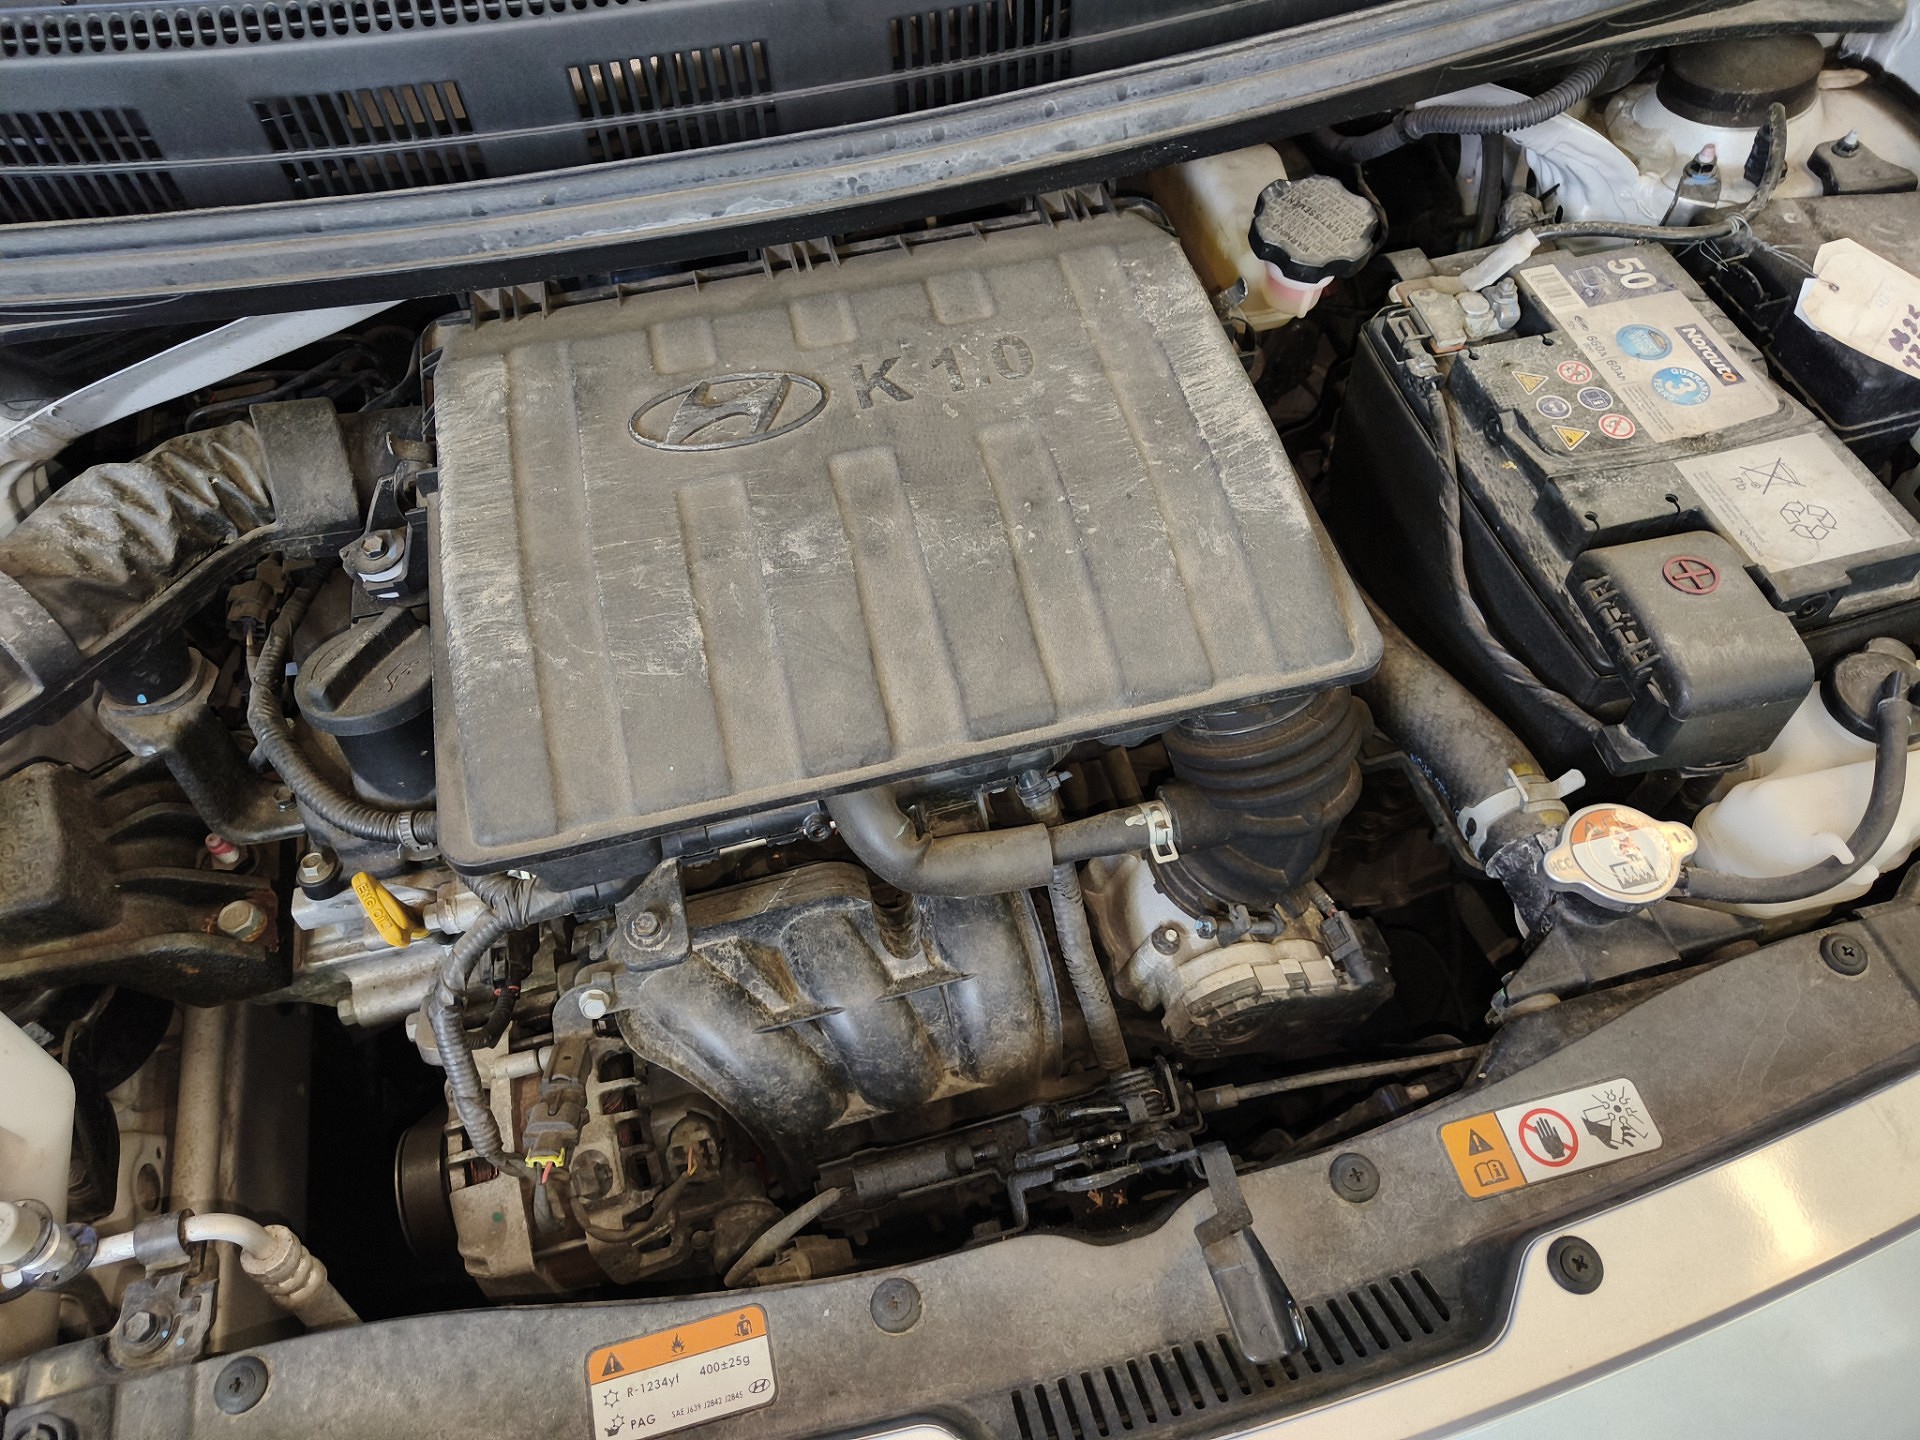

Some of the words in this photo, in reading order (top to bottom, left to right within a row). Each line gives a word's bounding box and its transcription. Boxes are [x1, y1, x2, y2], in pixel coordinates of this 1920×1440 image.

[1272, 224, 1311, 253] WARNING
[1607, 257, 1657, 290] 50
[850, 356, 914, 410] K
[929, 334, 1035, 393] 1.0
[1680, 326, 1738, 383] Norauto
[1665, 377, 1697, 395] 3
[1730, 476, 1746, 491] Pb
[1549, 857, 1574, 873] HCC
[356, 883, 376, 907] ENG
[372, 909, 393, 929] OIL
[627, 1373, 680, 1398] R-1234yf
[699, 1355, 751, 1376] 400±25g
[630, 1414, 656, 1430] PAG
[671, 1407, 685, 1419] SAE
[686, 1403, 703, 1415] J639
[703, 1398, 723, 1410] J2842
[724, 1390, 744, 1403] J2845
